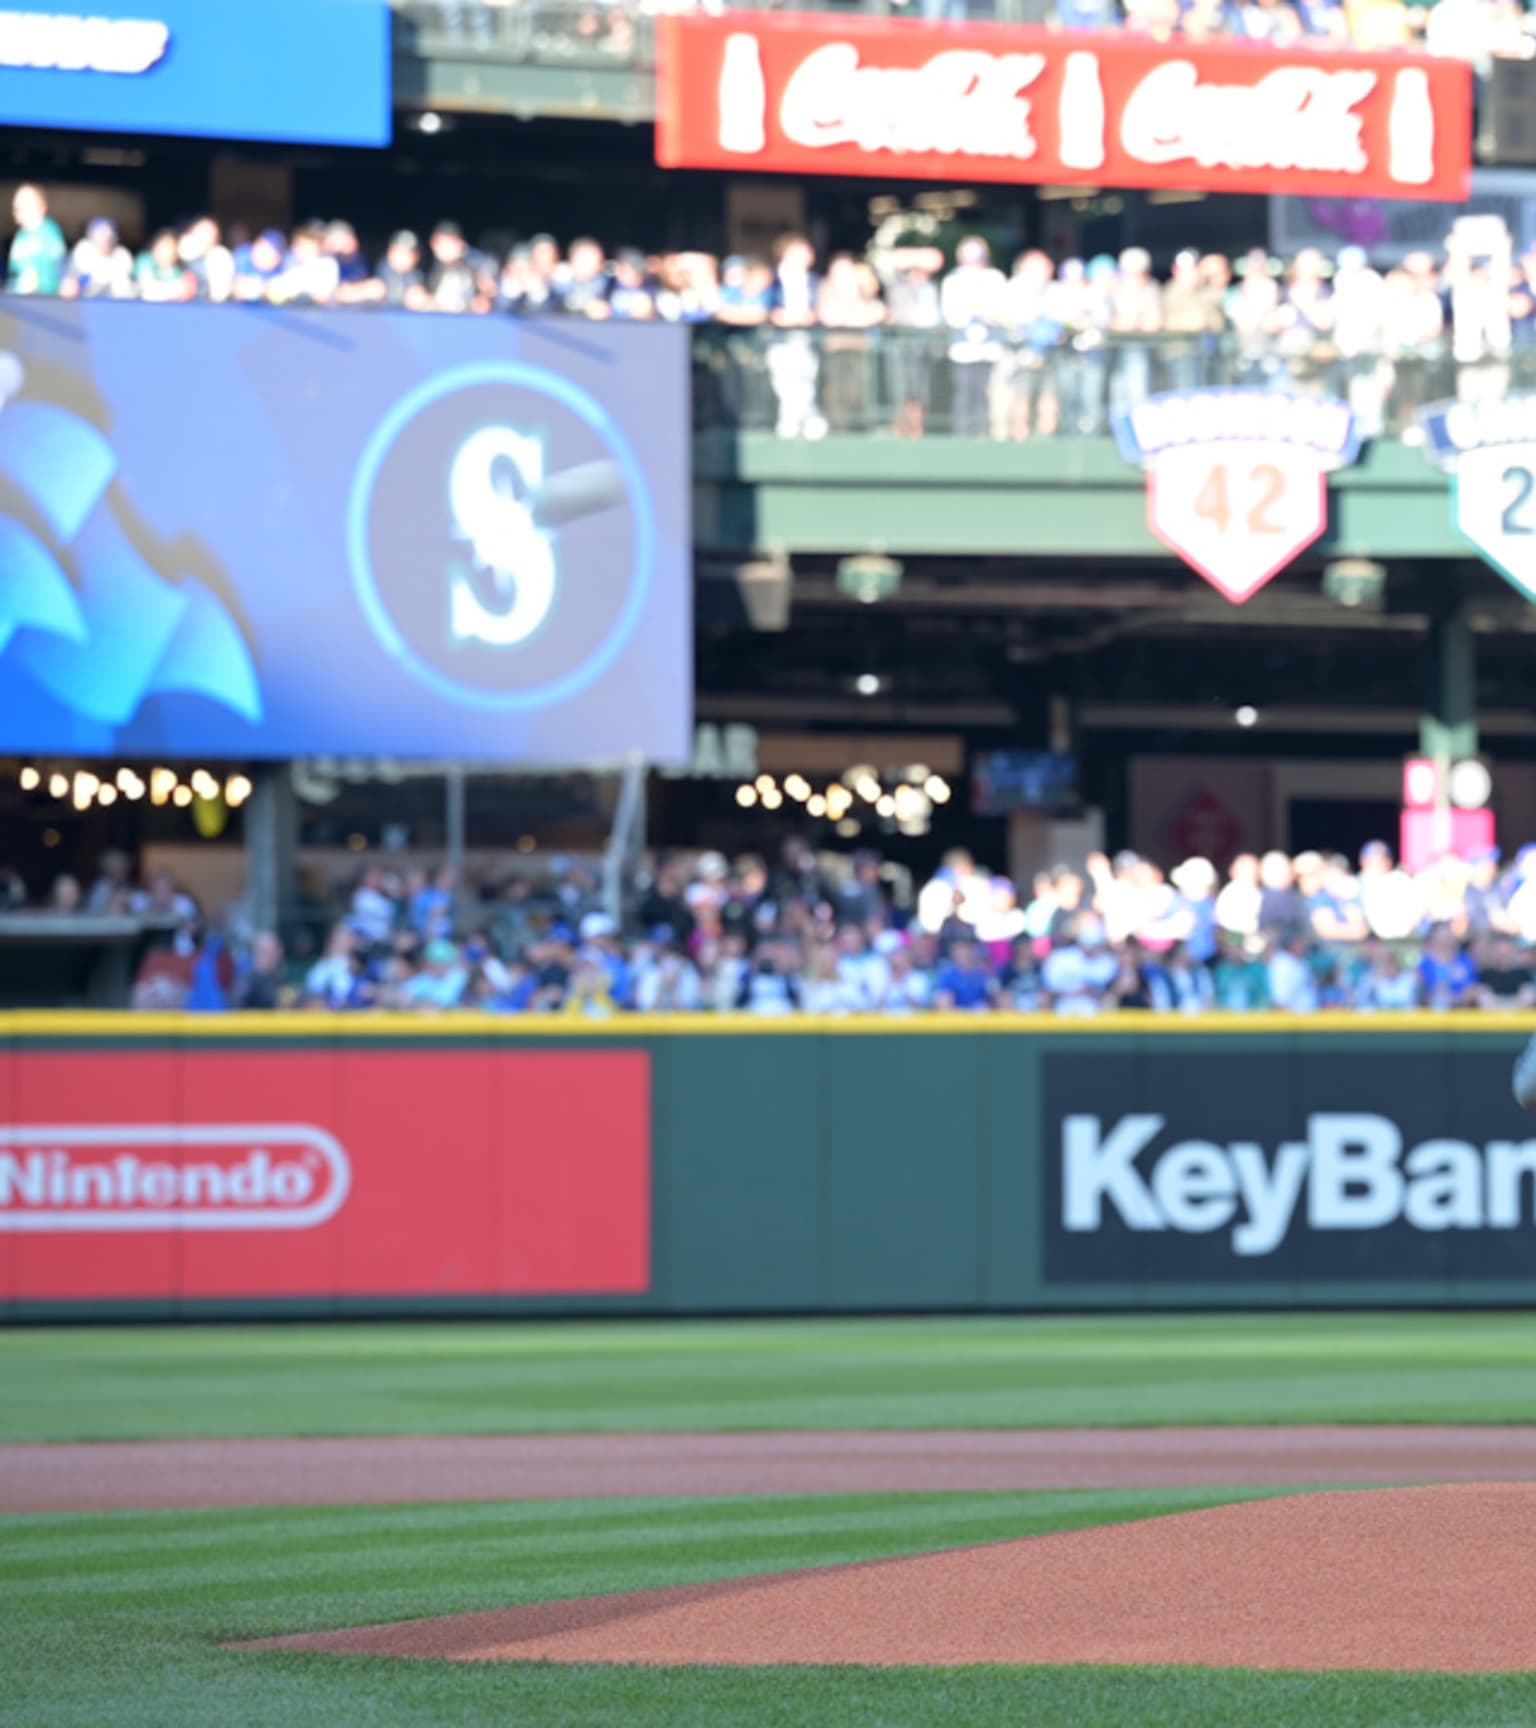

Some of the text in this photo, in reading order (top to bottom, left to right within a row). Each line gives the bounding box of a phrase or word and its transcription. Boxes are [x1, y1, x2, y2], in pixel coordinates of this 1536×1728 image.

[1193, 463, 1288, 535] 42
[448, 422, 557, 646] S
[660, 723, 759, 780] AR
[0, 1149, 315, 1204] Nintendo
